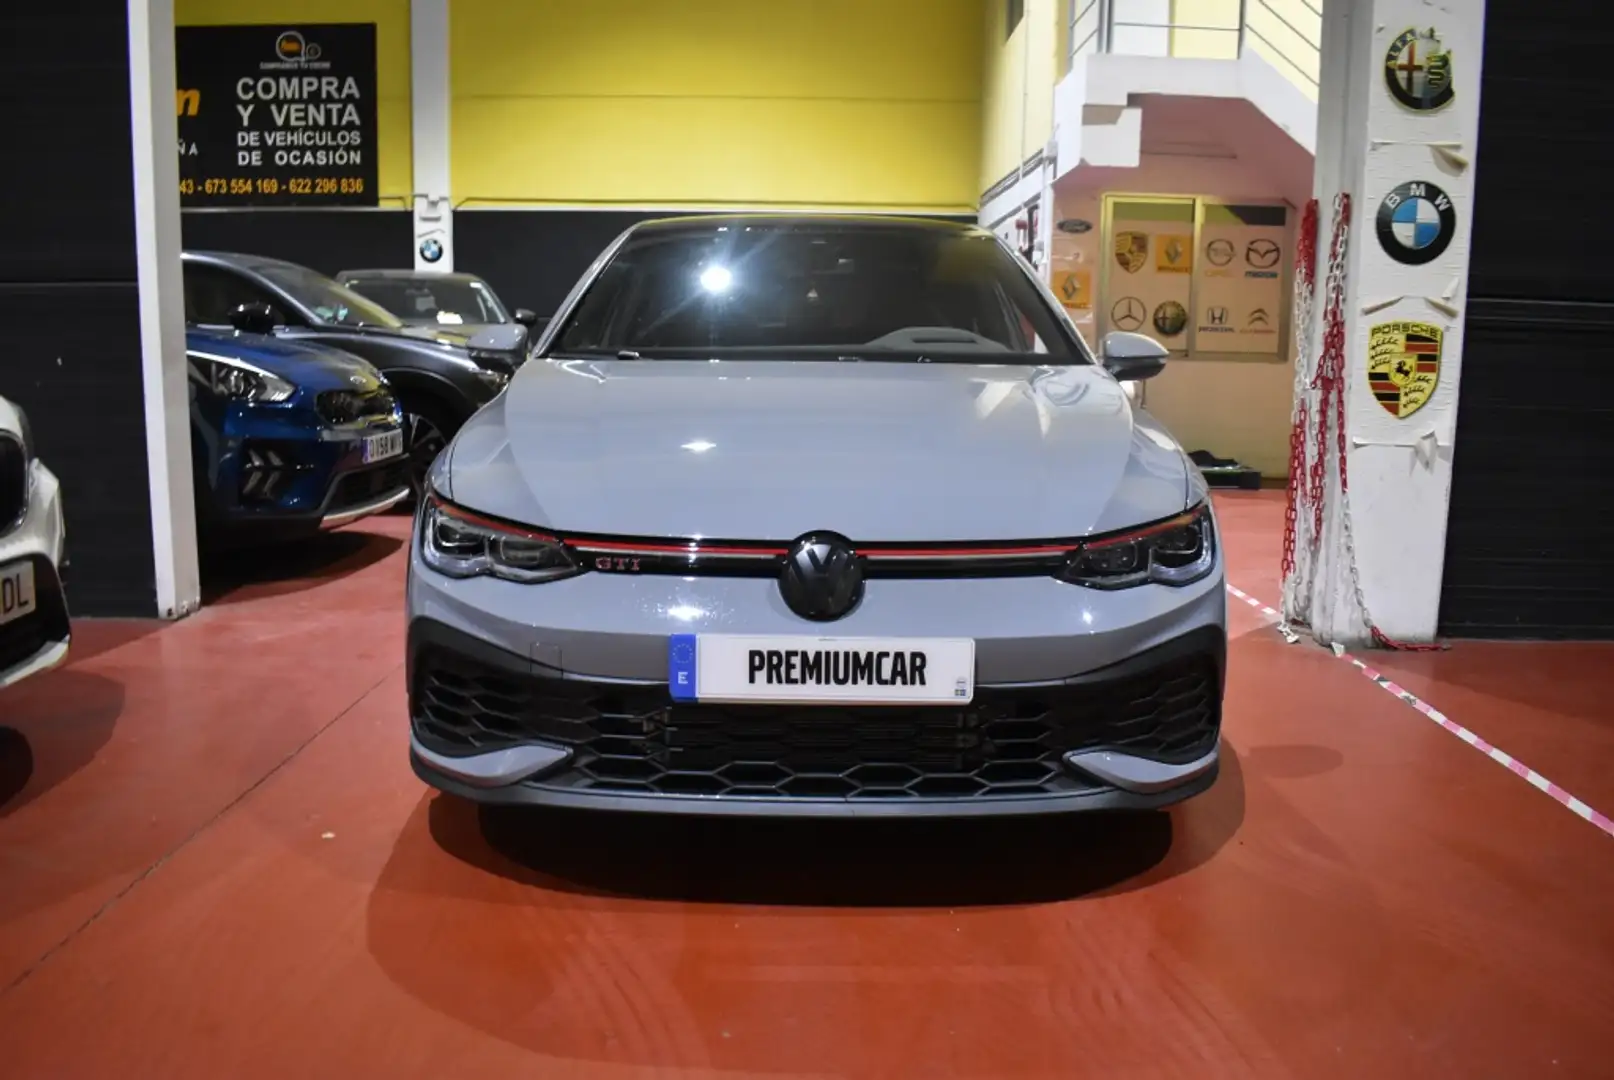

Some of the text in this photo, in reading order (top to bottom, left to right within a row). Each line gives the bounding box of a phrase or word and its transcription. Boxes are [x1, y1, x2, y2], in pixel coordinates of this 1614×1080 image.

[236, 76, 361, 100] COMPRA
[236, 103, 361, 127] Y VENTA
[237, 128, 361, 147] DE VEHÍCULOS
[238, 147, 361, 166] DE OCASIÓN
[205, 179, 227, 194] 673
[1387, 183, 1450, 211] BMW
[1371, 322, 1439, 338] PORSCHE
[595, 557, 640, 571] GTI
[3, 573, 29, 614] DL
[748, 649, 927, 686] PREMIUMCAR
[677, 671, 688, 684] E
